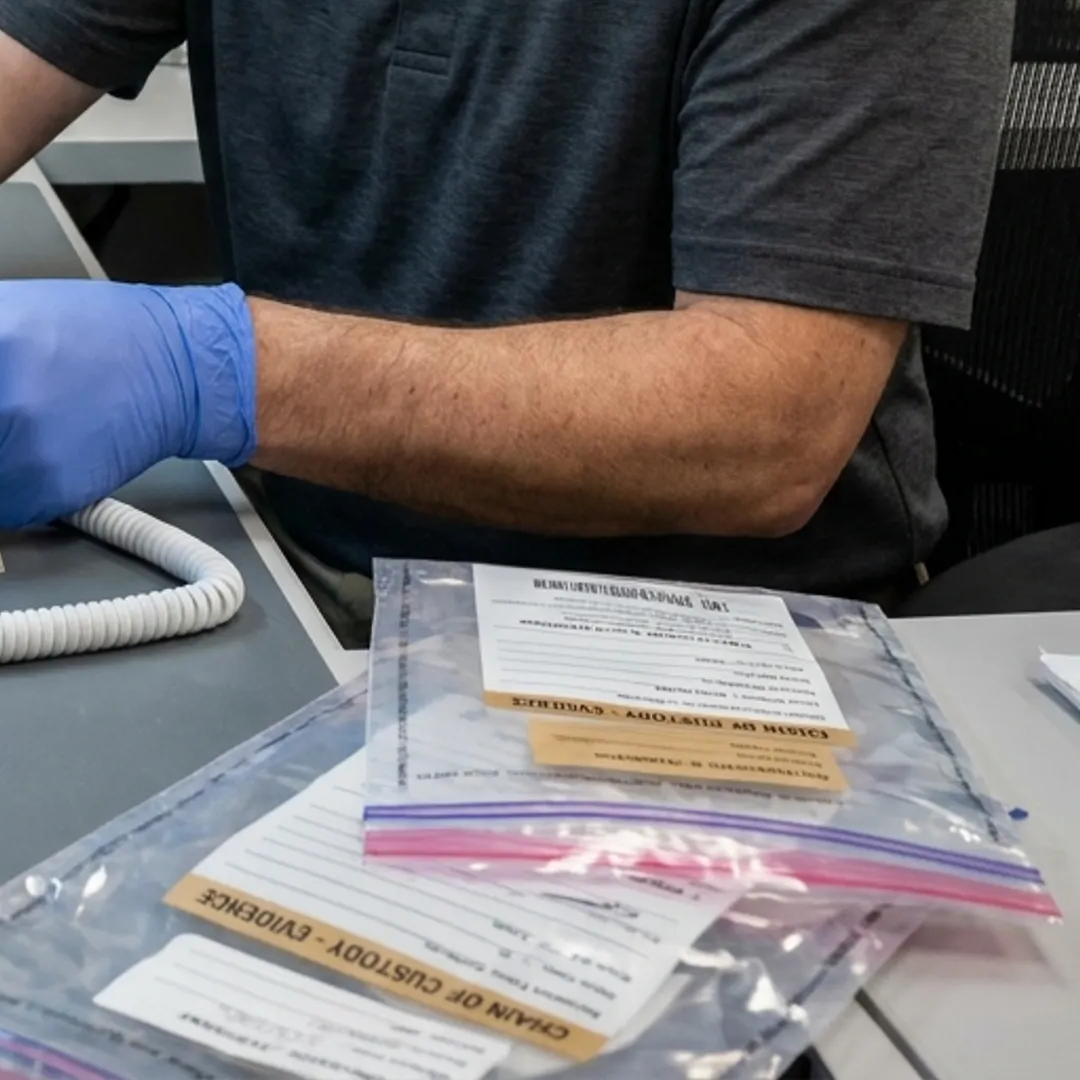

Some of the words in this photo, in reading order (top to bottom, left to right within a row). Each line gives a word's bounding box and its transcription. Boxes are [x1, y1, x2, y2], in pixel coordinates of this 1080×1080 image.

[195, 888, 312, 943] EVIDENCE
[327, 938, 443, 996] CUSTODY
[445, 987, 484, 1010] OF
[486, 1001, 570, 1041] CHAIN
